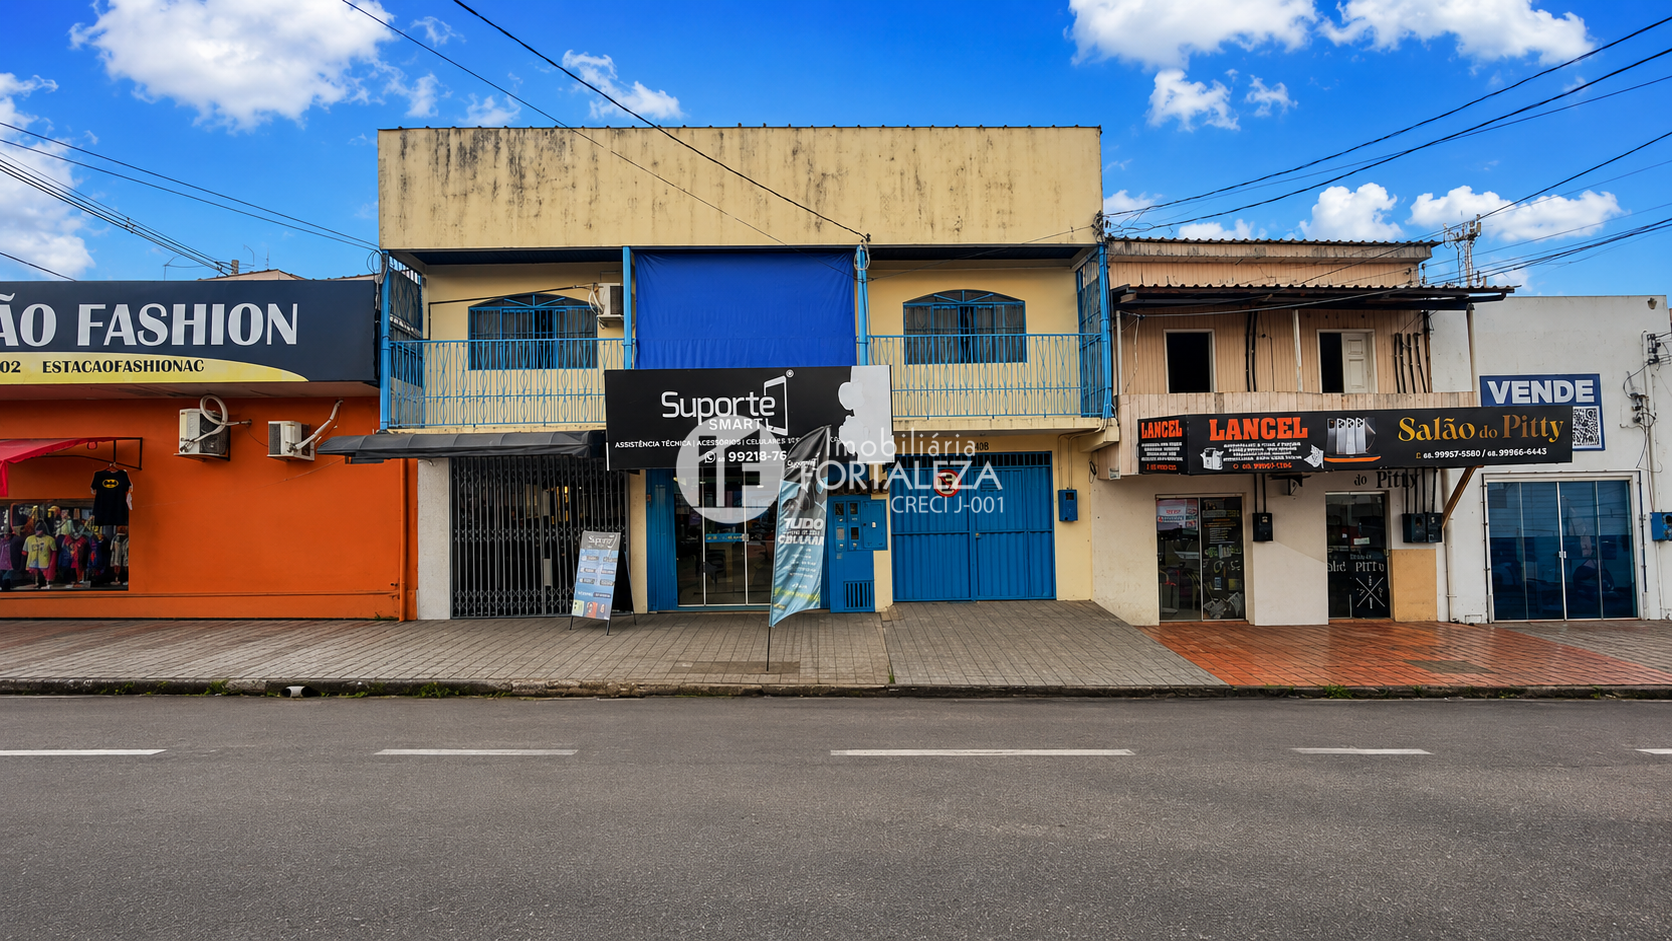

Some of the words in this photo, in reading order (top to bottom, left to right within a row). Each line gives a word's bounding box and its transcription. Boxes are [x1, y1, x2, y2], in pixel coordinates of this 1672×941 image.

[77, 302, 298, 346] FASHION
[42, 359, 205, 374] ESTACAOFASHIONAC
[1487, 380, 1595, 404] VENDE
[661, 391, 776, 426] Suporte
[709, 418, 763, 431] SMART
[1141, 419, 1183, 439] LANCEL
[1209, 417, 1308, 441] LANCEL
[1398, 416, 1476, 442] Salão
[1479, 424, 1498, 439] do
[1502, 414, 1565, 443] Pitty
[615, 440, 660, 448] ASSISTÊNCIA
[661, 439, 692, 447] TÉCNICA
[697, 438, 741, 447] ACESSÓRIOS
[1354, 474, 1368, 486] do
[784, 517, 824, 530] TUDO
